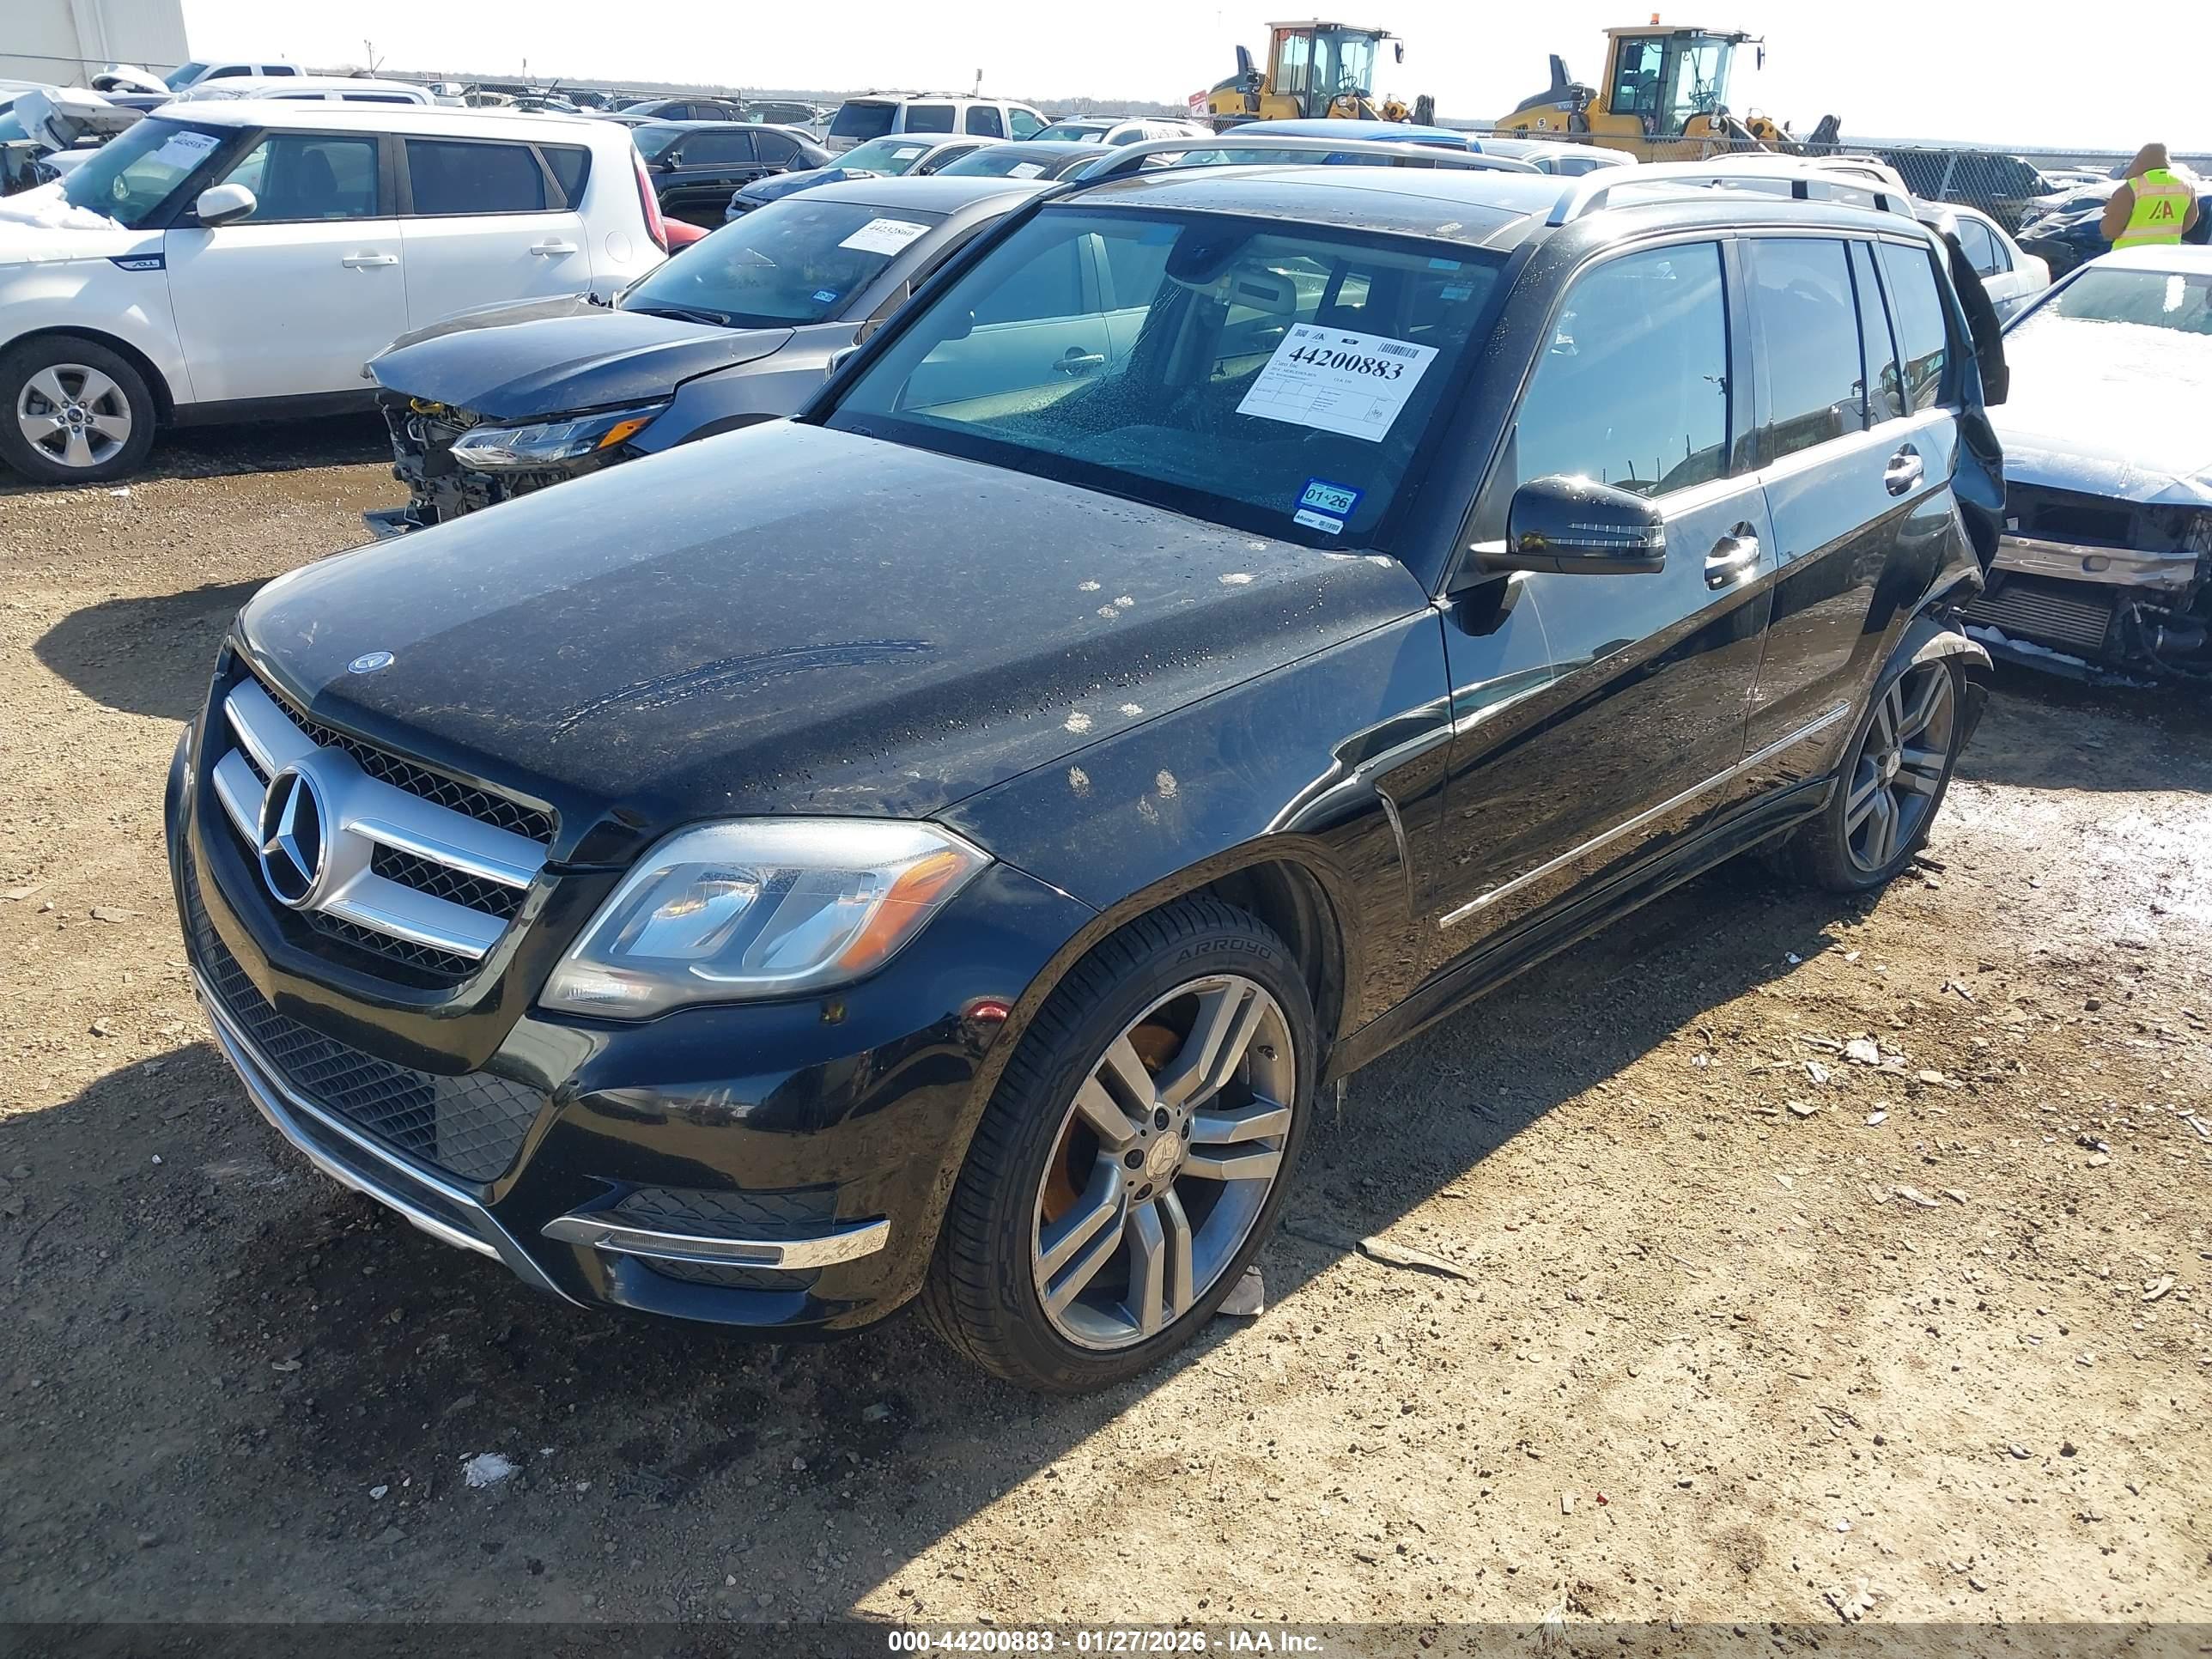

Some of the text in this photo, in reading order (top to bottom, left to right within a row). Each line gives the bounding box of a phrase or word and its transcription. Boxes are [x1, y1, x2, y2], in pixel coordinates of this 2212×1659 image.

[1288, 345, 1404, 380] 44200883
[1305, 489, 1323, 502] 01
[1328, 495, 1350, 508] 26
[1176, 939, 1273, 964] ARROYO
